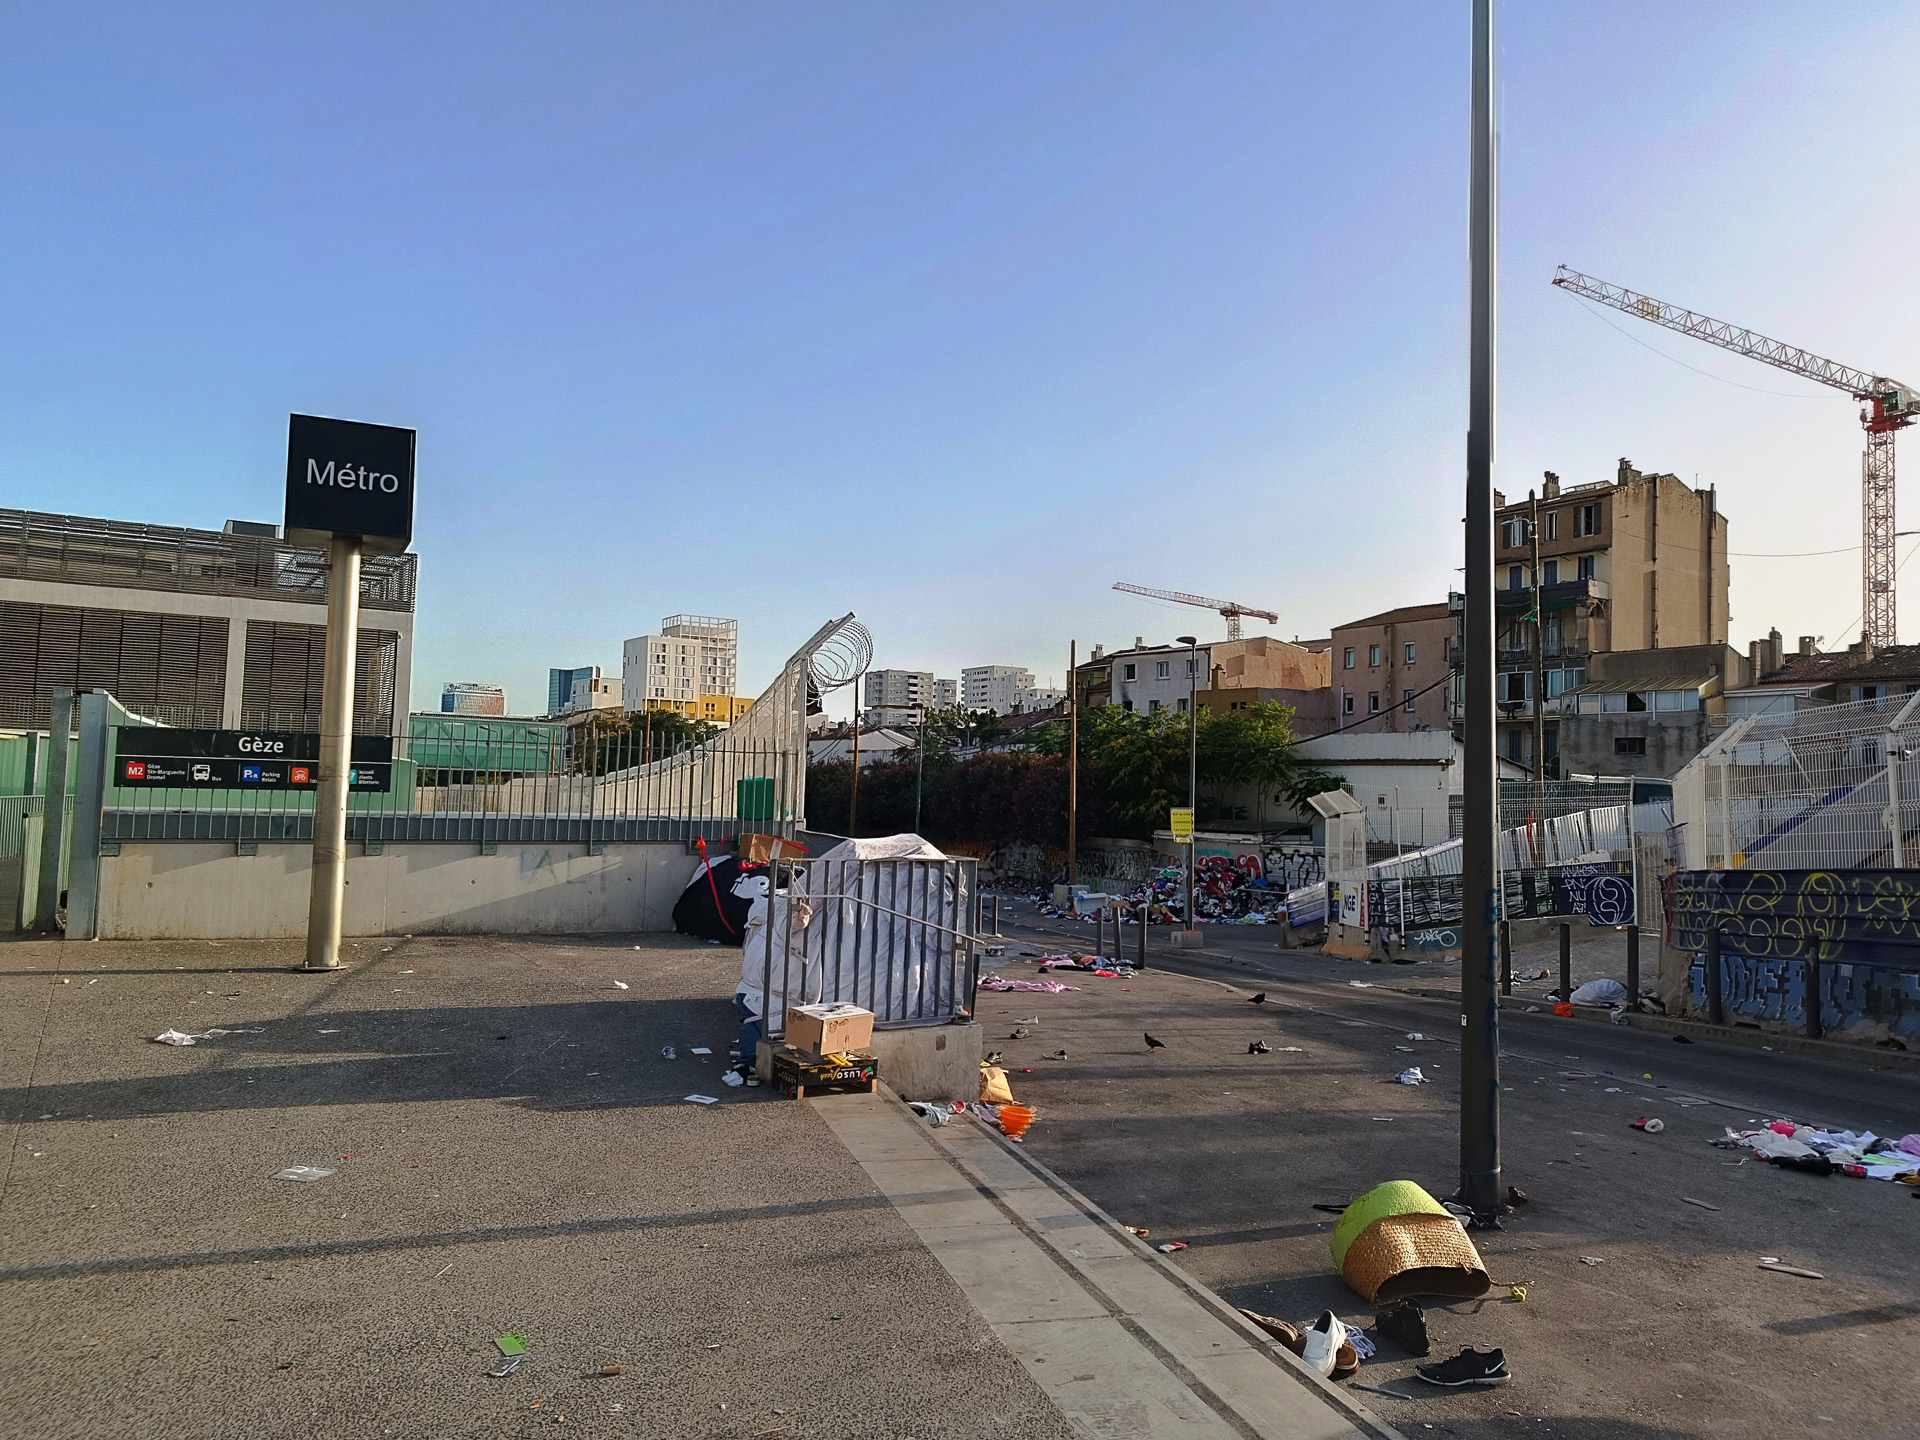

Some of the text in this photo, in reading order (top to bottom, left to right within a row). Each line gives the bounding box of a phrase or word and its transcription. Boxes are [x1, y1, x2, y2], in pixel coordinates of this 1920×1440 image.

[306, 458, 399, 493] Métro
[238, 736, 284, 753] Gèze
[128, 766, 143, 775] M2
[1344, 893, 1356, 912] NGE
